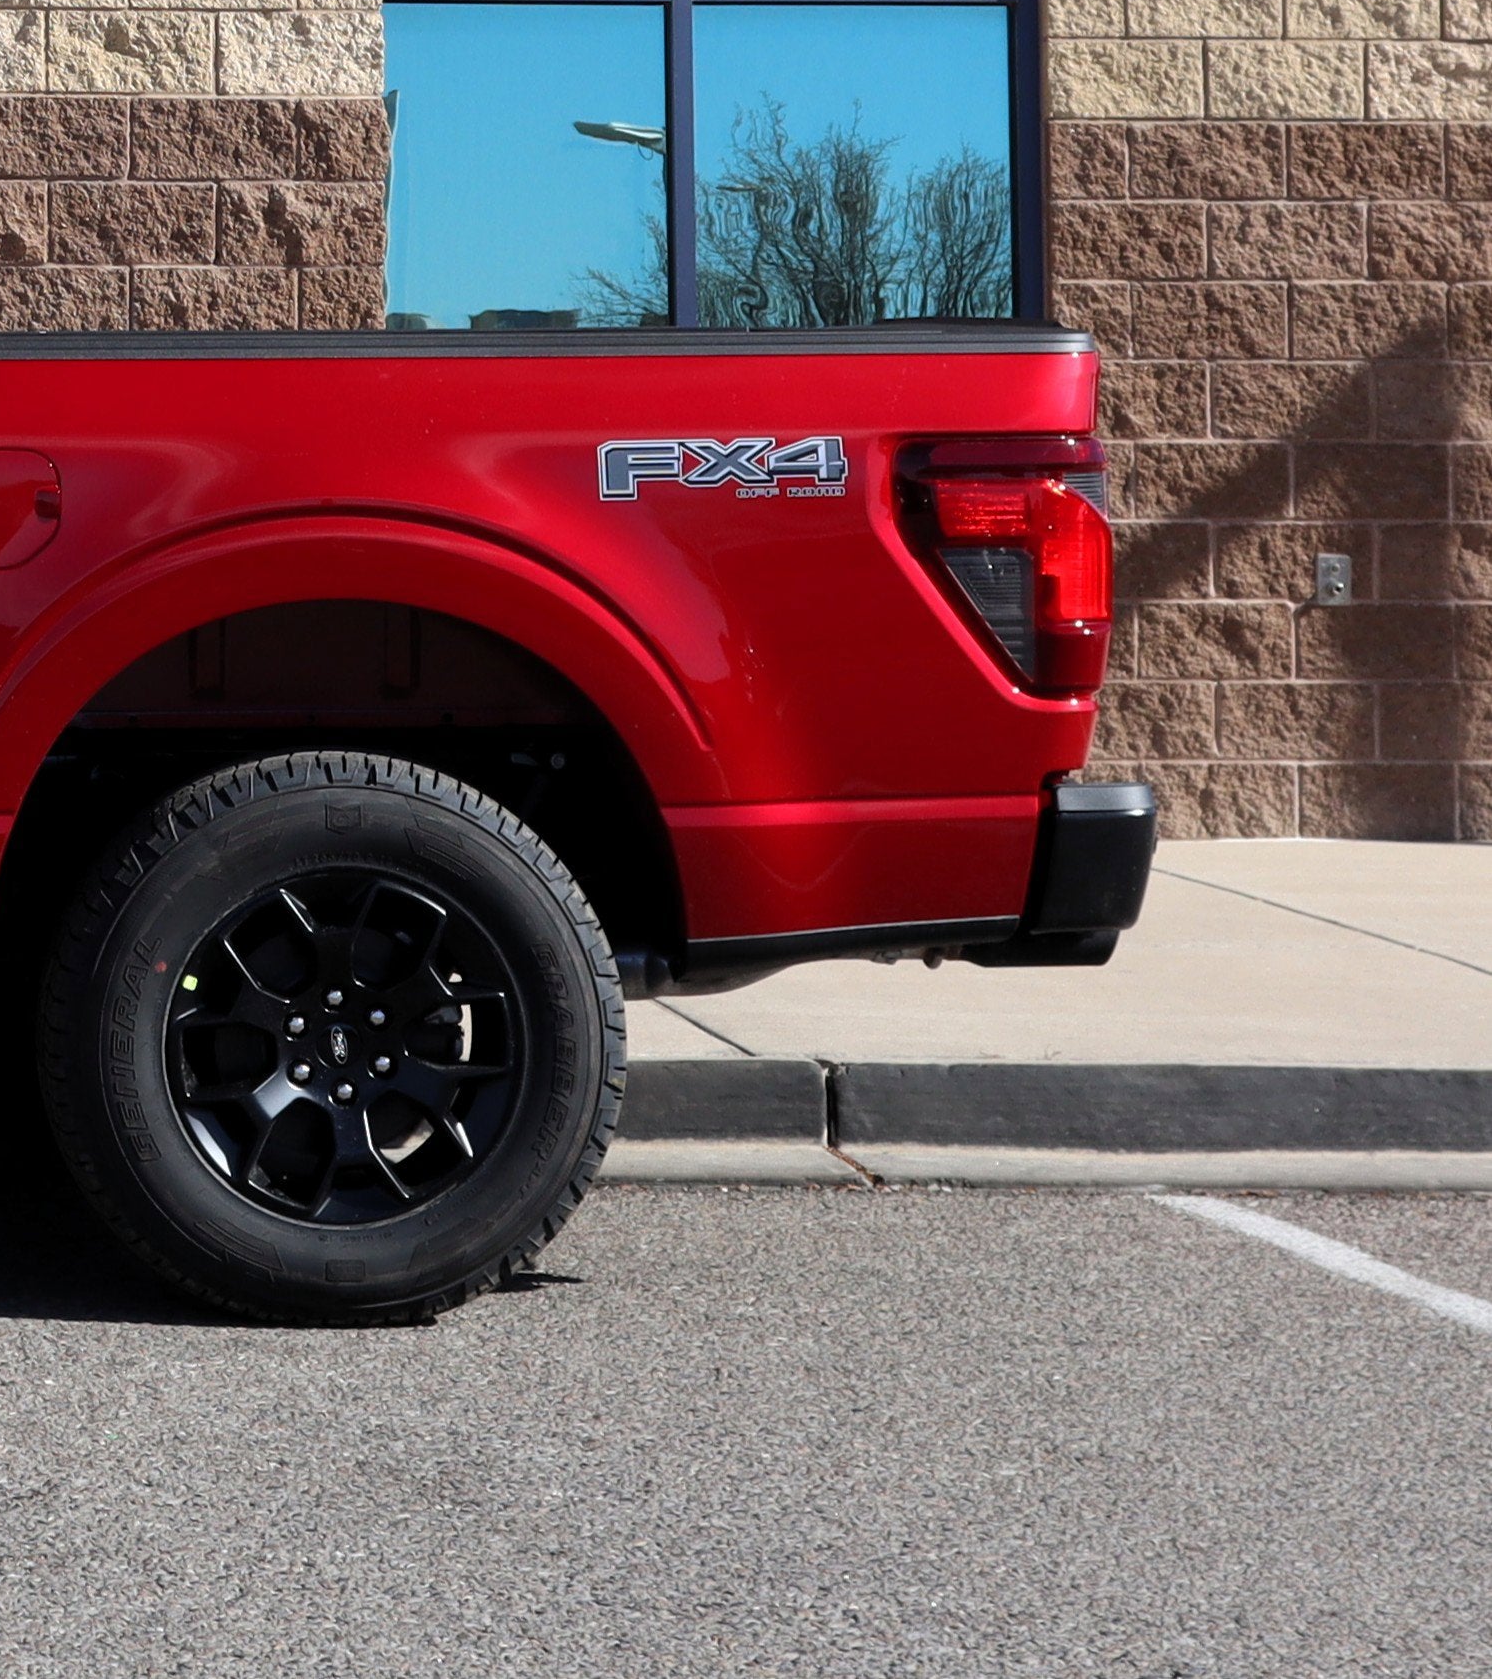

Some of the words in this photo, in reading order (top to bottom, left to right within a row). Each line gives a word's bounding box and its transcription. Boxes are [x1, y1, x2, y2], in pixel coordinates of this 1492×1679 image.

[597, 436, 849, 502] FX4
[735, 487, 781, 499] OFF
[786, 486, 846, 499] ROAD
[110, 938, 162, 1162] GENERAL
[530, 942, 576, 1161] GRABBER
